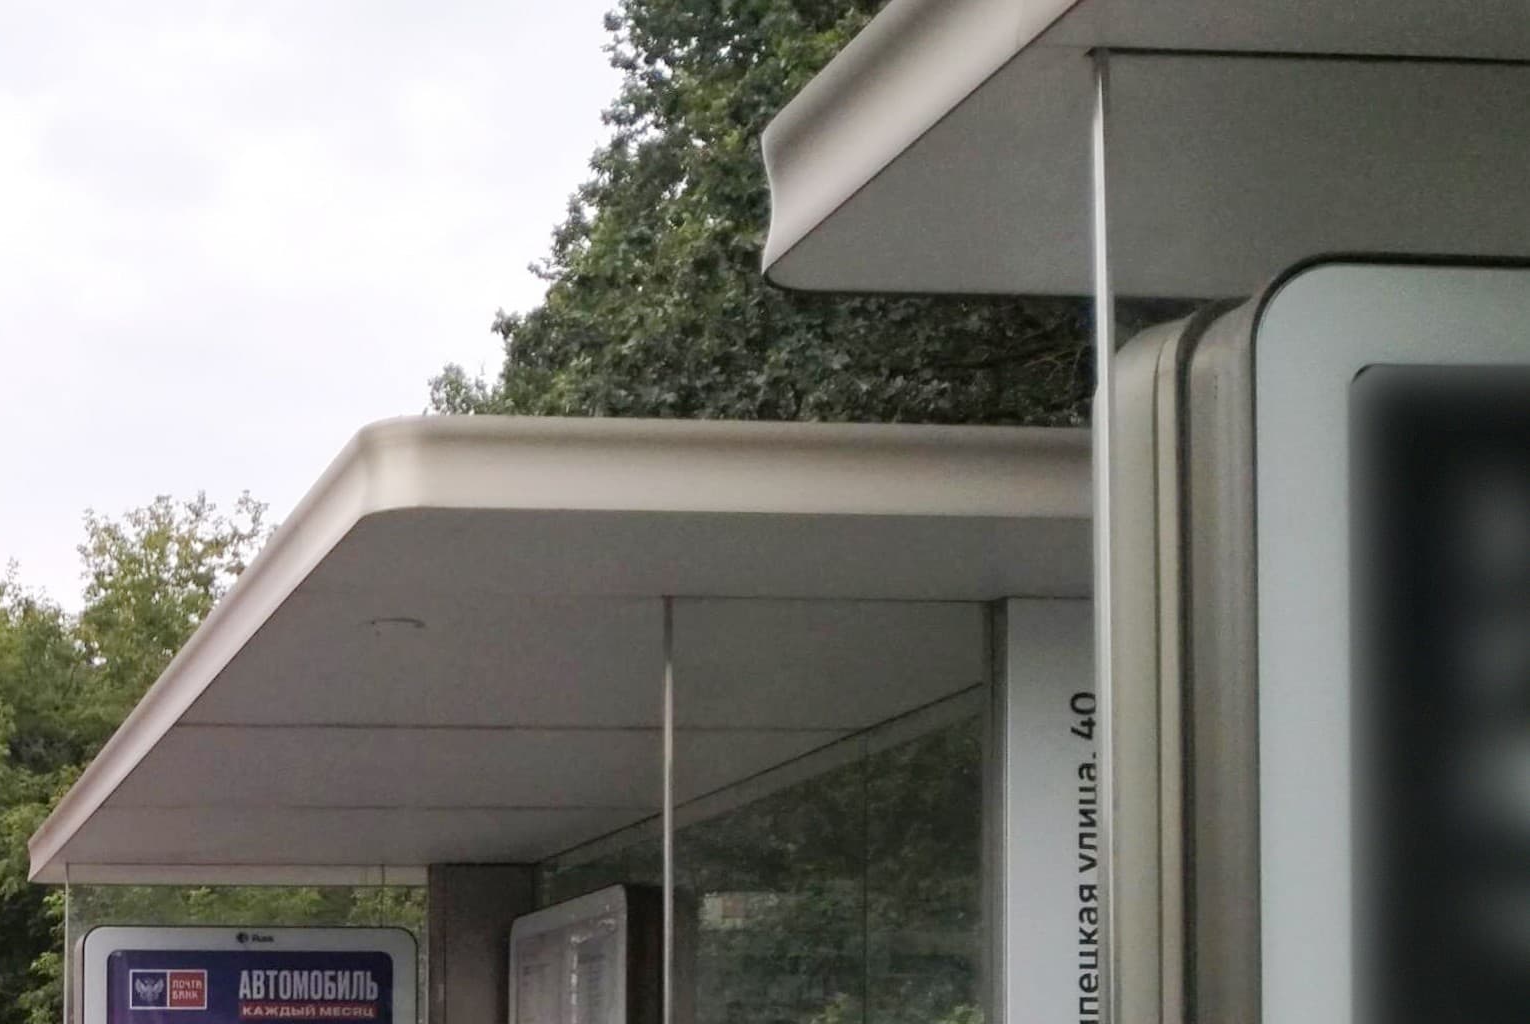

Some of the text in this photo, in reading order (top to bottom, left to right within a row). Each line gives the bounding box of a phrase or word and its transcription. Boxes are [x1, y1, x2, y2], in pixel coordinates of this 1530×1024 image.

[1070, 691, 1097, 741] 40
[171, 980, 203, 990] ПОЧТА
[238, 969, 380, 1001] АВТОМОБИЛЬ
[171, 989, 199, 1000] БАНК
[242, 1005, 375, 1018] КАЖДЫЙ МЕСЯЦ
